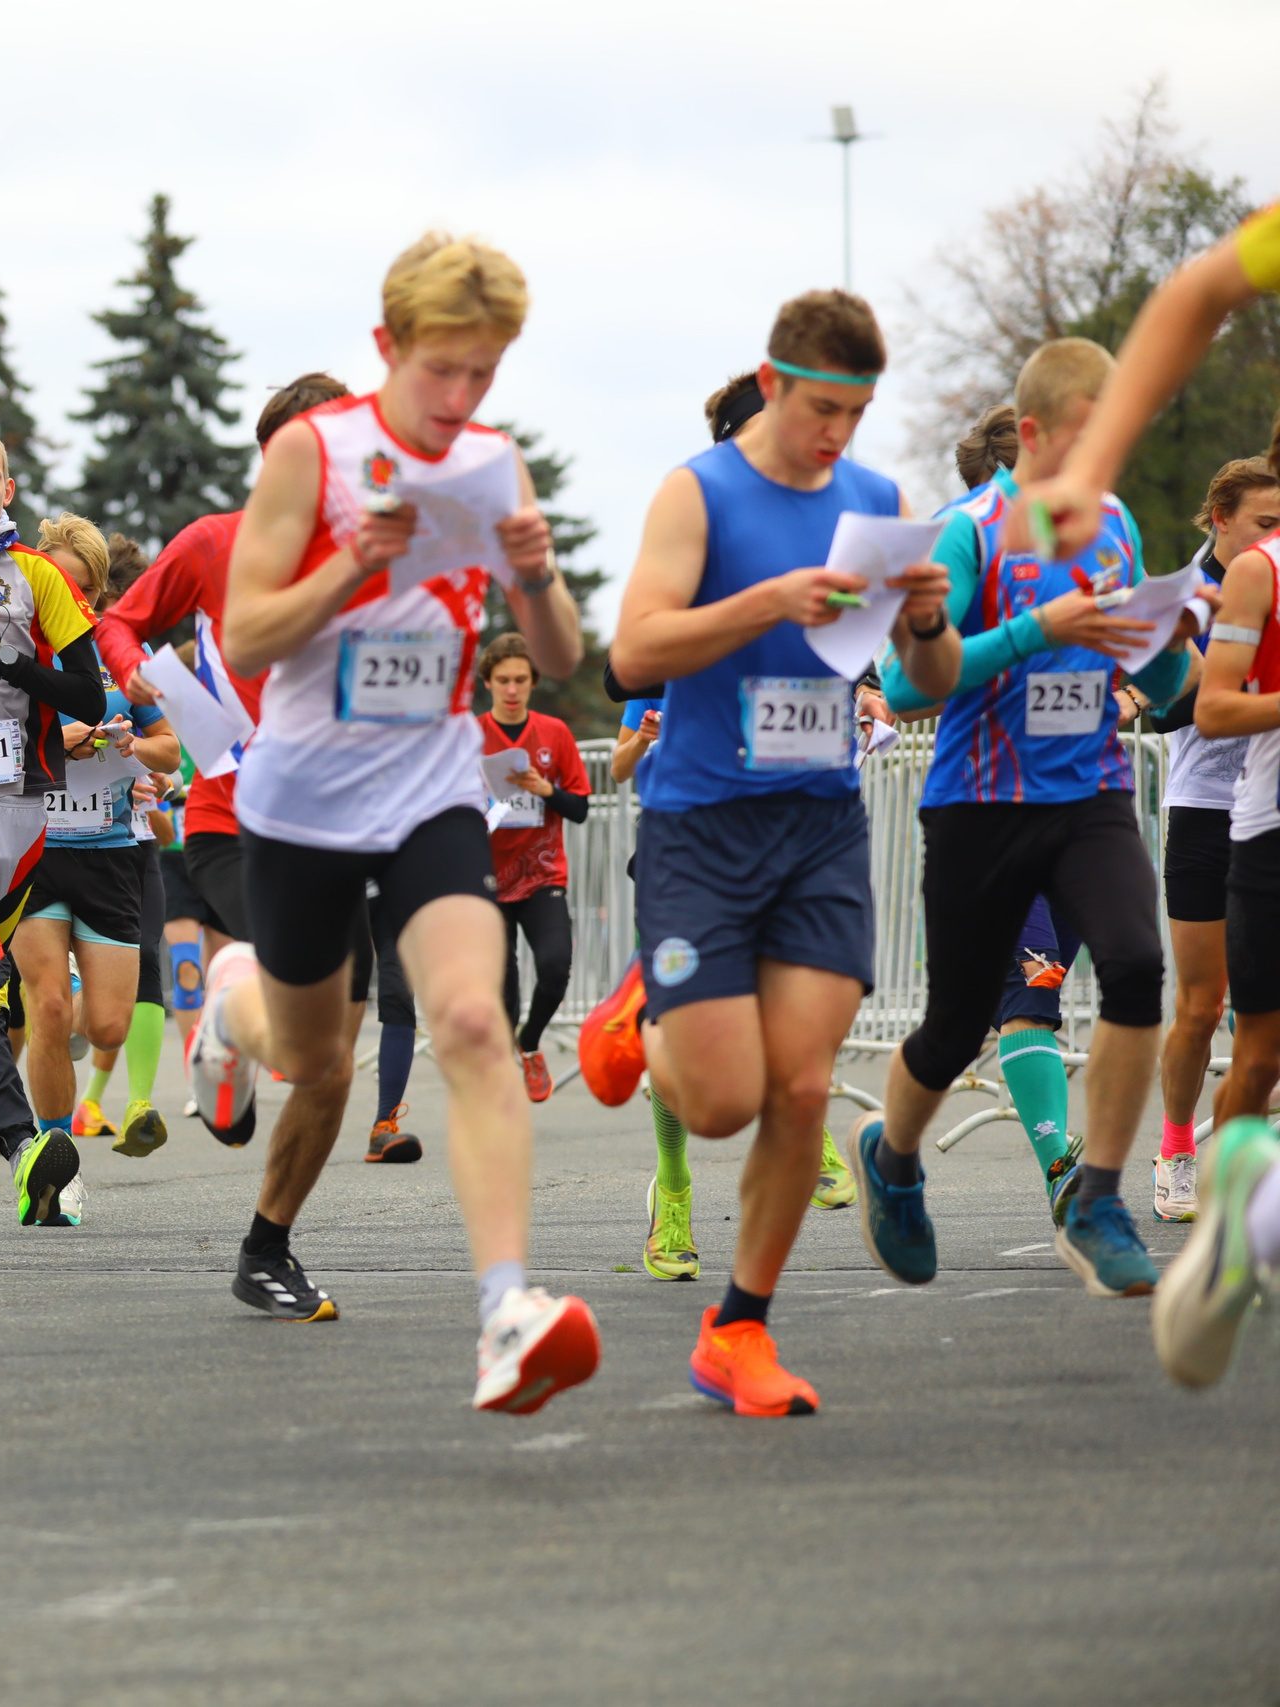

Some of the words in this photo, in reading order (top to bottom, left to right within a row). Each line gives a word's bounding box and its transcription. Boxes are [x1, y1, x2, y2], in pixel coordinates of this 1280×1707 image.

[363, 655, 446, 687] 229.1
[1029, 683, 1101, 711] 225.1
[759, 702, 838, 732] 220.1
